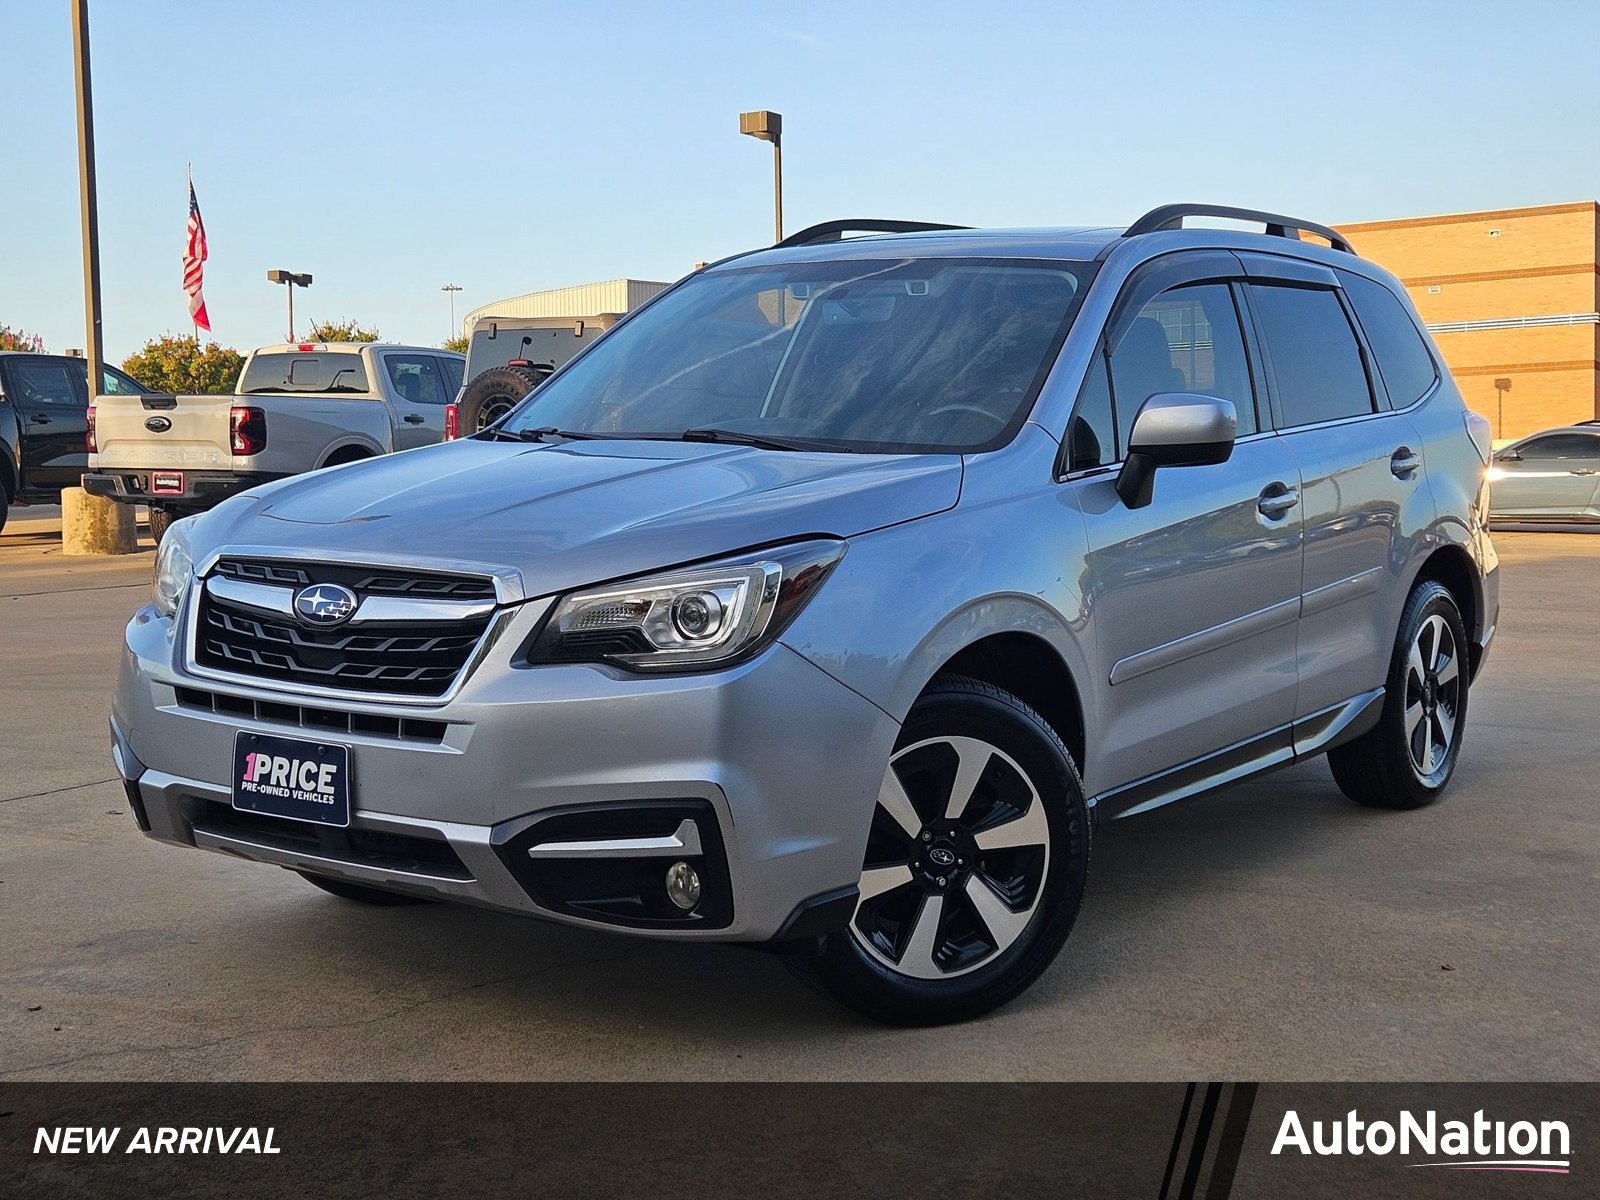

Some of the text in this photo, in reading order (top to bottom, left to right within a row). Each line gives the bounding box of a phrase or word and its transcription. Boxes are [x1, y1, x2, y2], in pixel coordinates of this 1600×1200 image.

[243, 752, 337, 794] 1PRICE
[241, 781, 335, 805] PRE-OWNED VEHICLES
